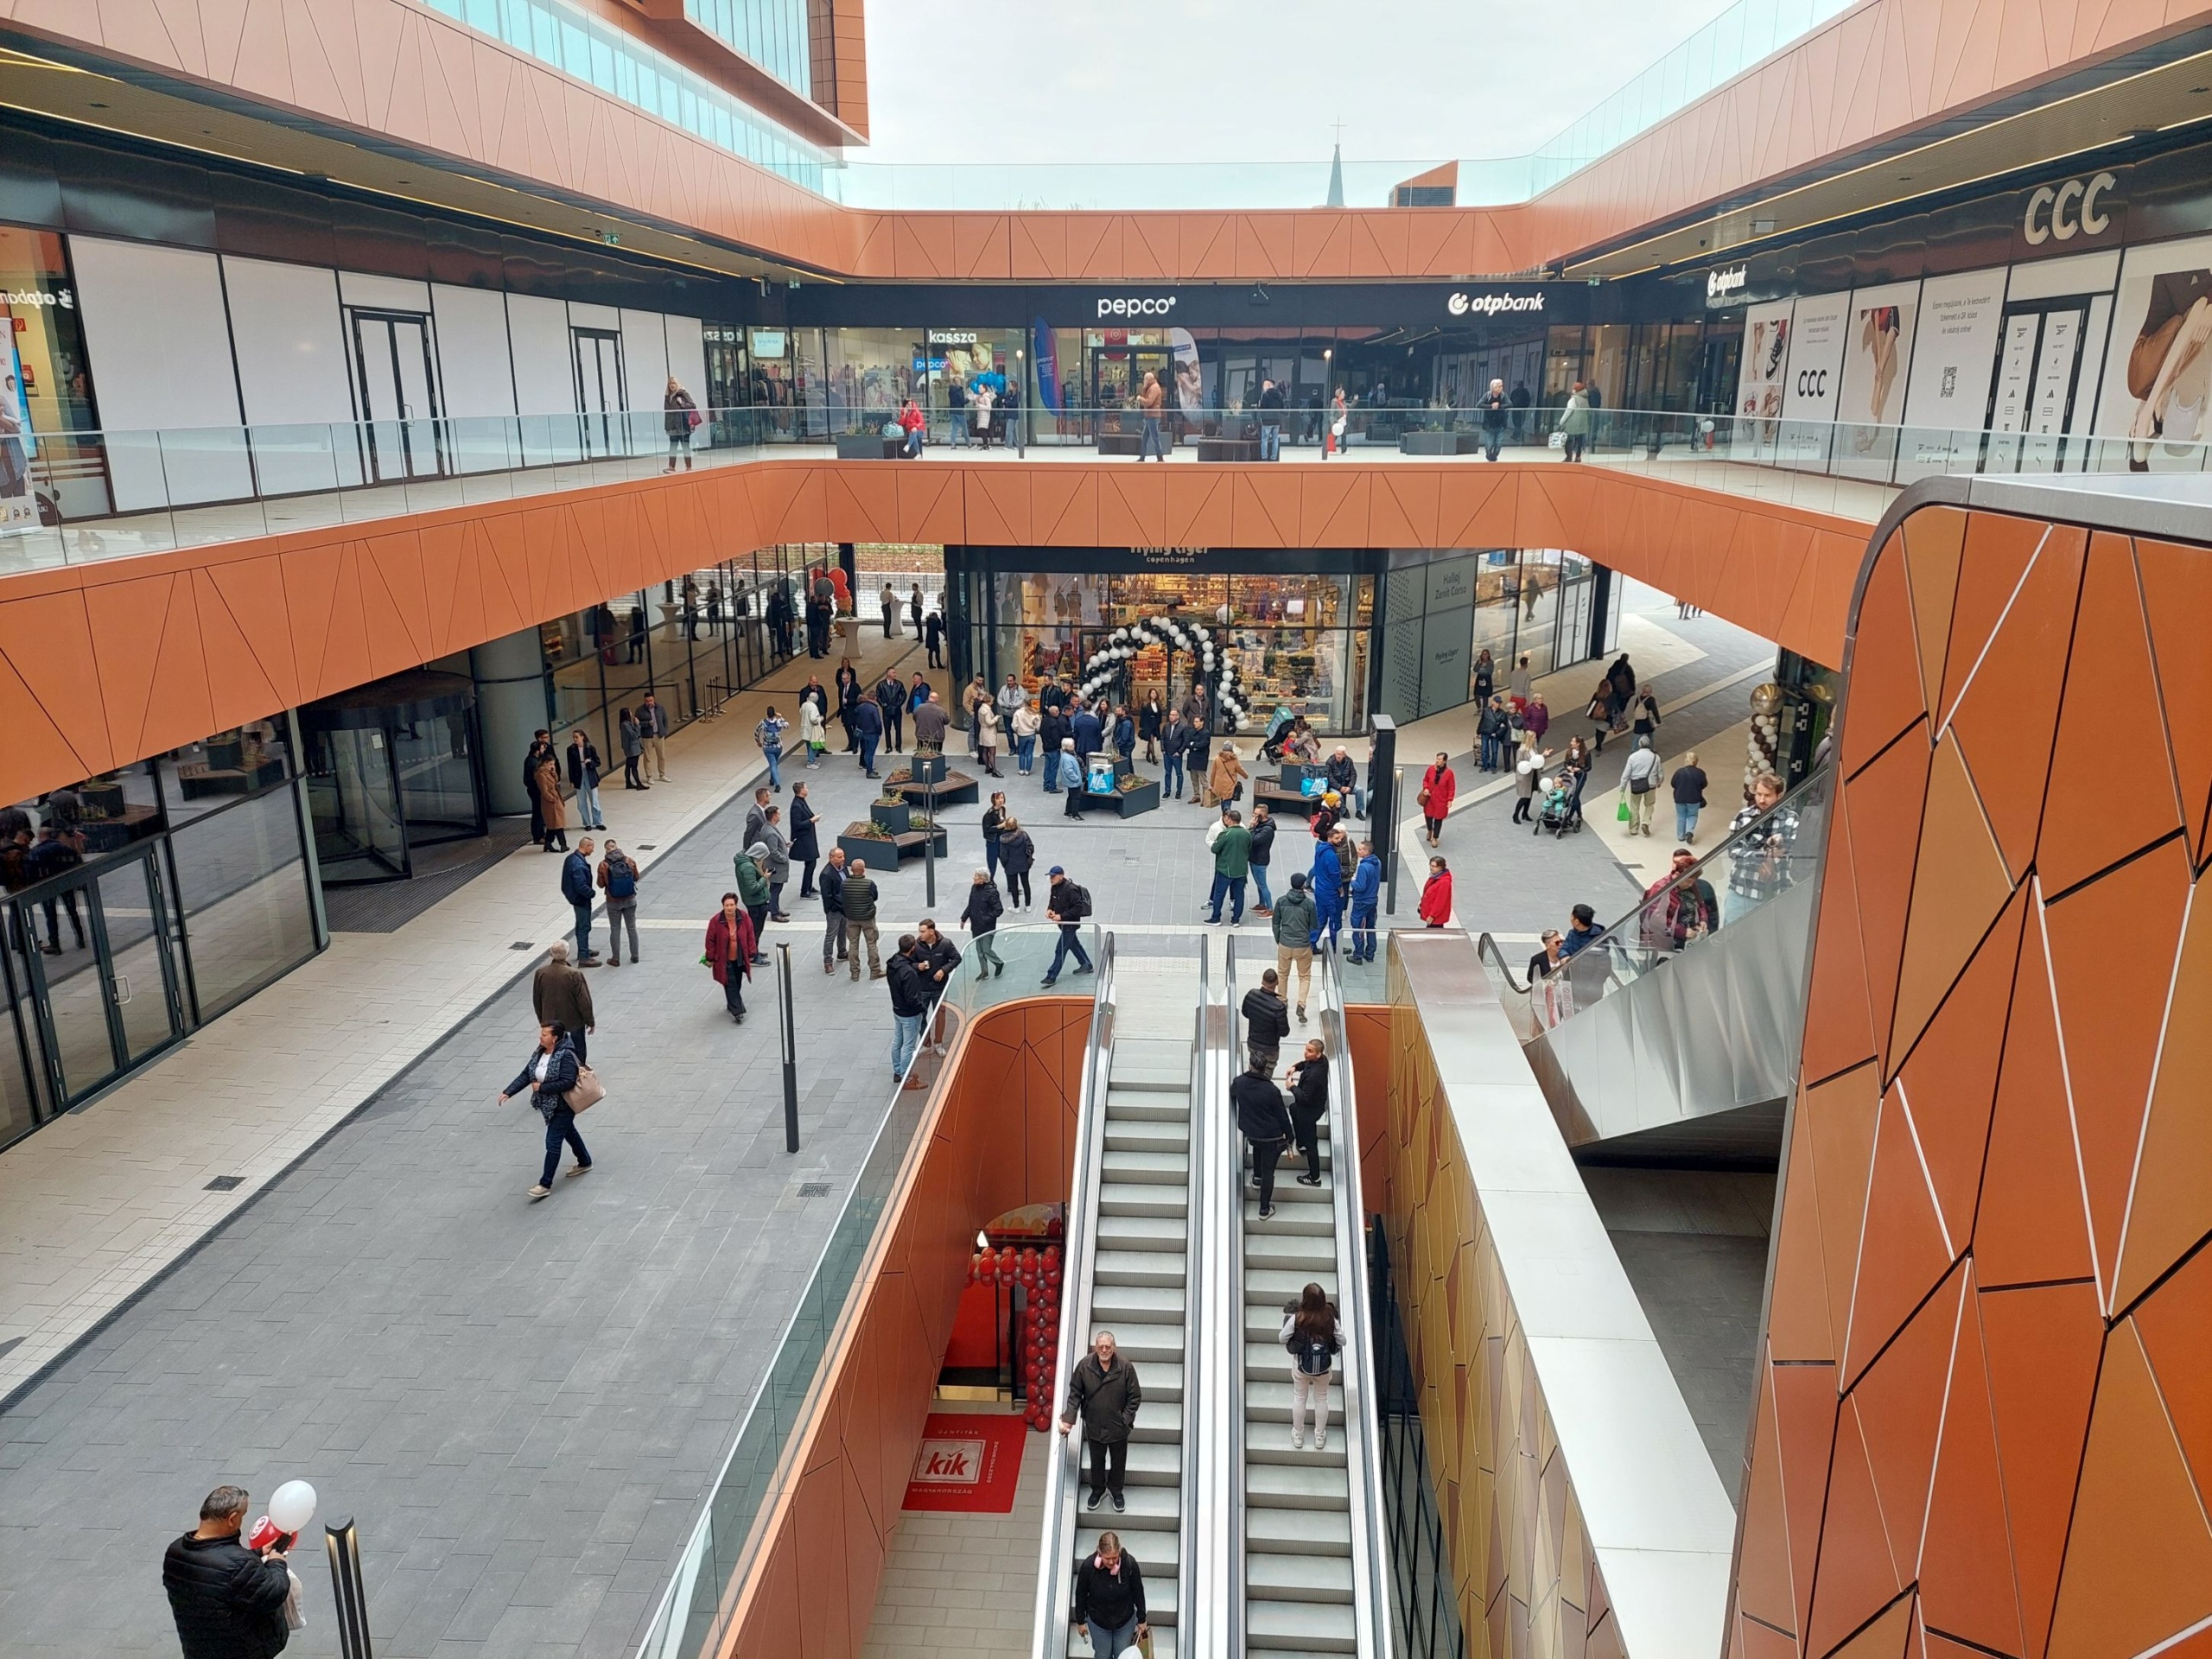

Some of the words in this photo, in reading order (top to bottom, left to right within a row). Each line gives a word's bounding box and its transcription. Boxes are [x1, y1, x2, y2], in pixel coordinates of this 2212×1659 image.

[2024, 172, 2117, 245] CCC
[1716, 264, 1747, 296] otpbank
[1471, 292, 1545, 316] otpbank
[929, 329, 977, 344] kassza
[1797, 369, 1827, 397] CCC
[1146, 556, 1195, 564] copenhagen
[1451, 586, 1467, 596] Corso
[925, 1449, 969, 1476] kik
